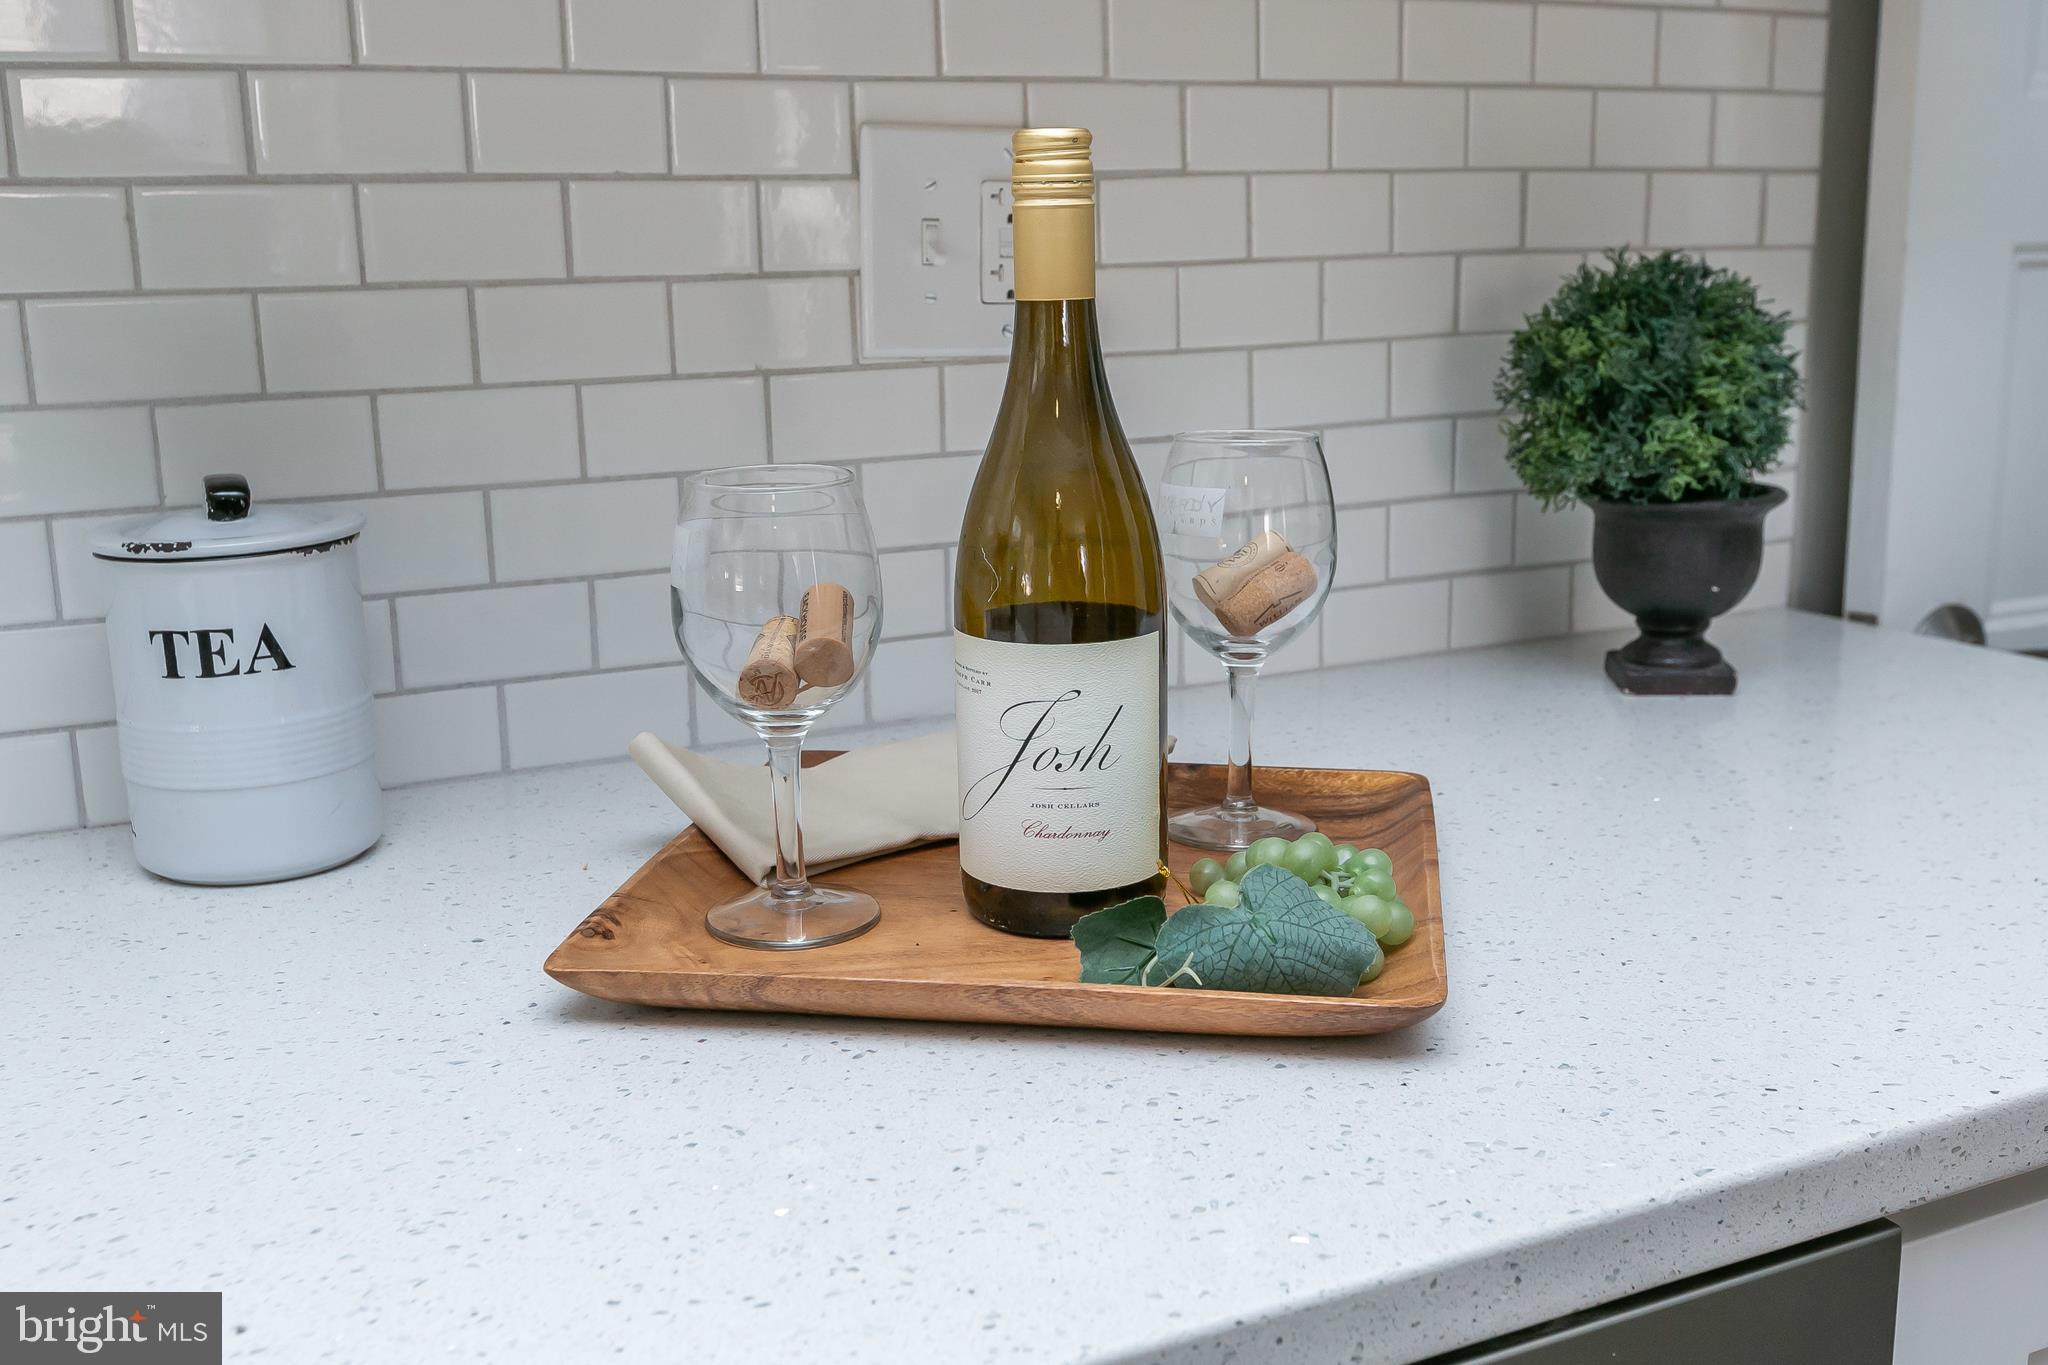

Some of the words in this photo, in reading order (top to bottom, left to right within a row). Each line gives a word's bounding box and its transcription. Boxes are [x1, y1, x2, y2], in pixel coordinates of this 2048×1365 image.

[148, 622, 296, 679] TEA
[963, 689, 1123, 821] Josh
[1021, 818, 1112, 843] Chardonnay
